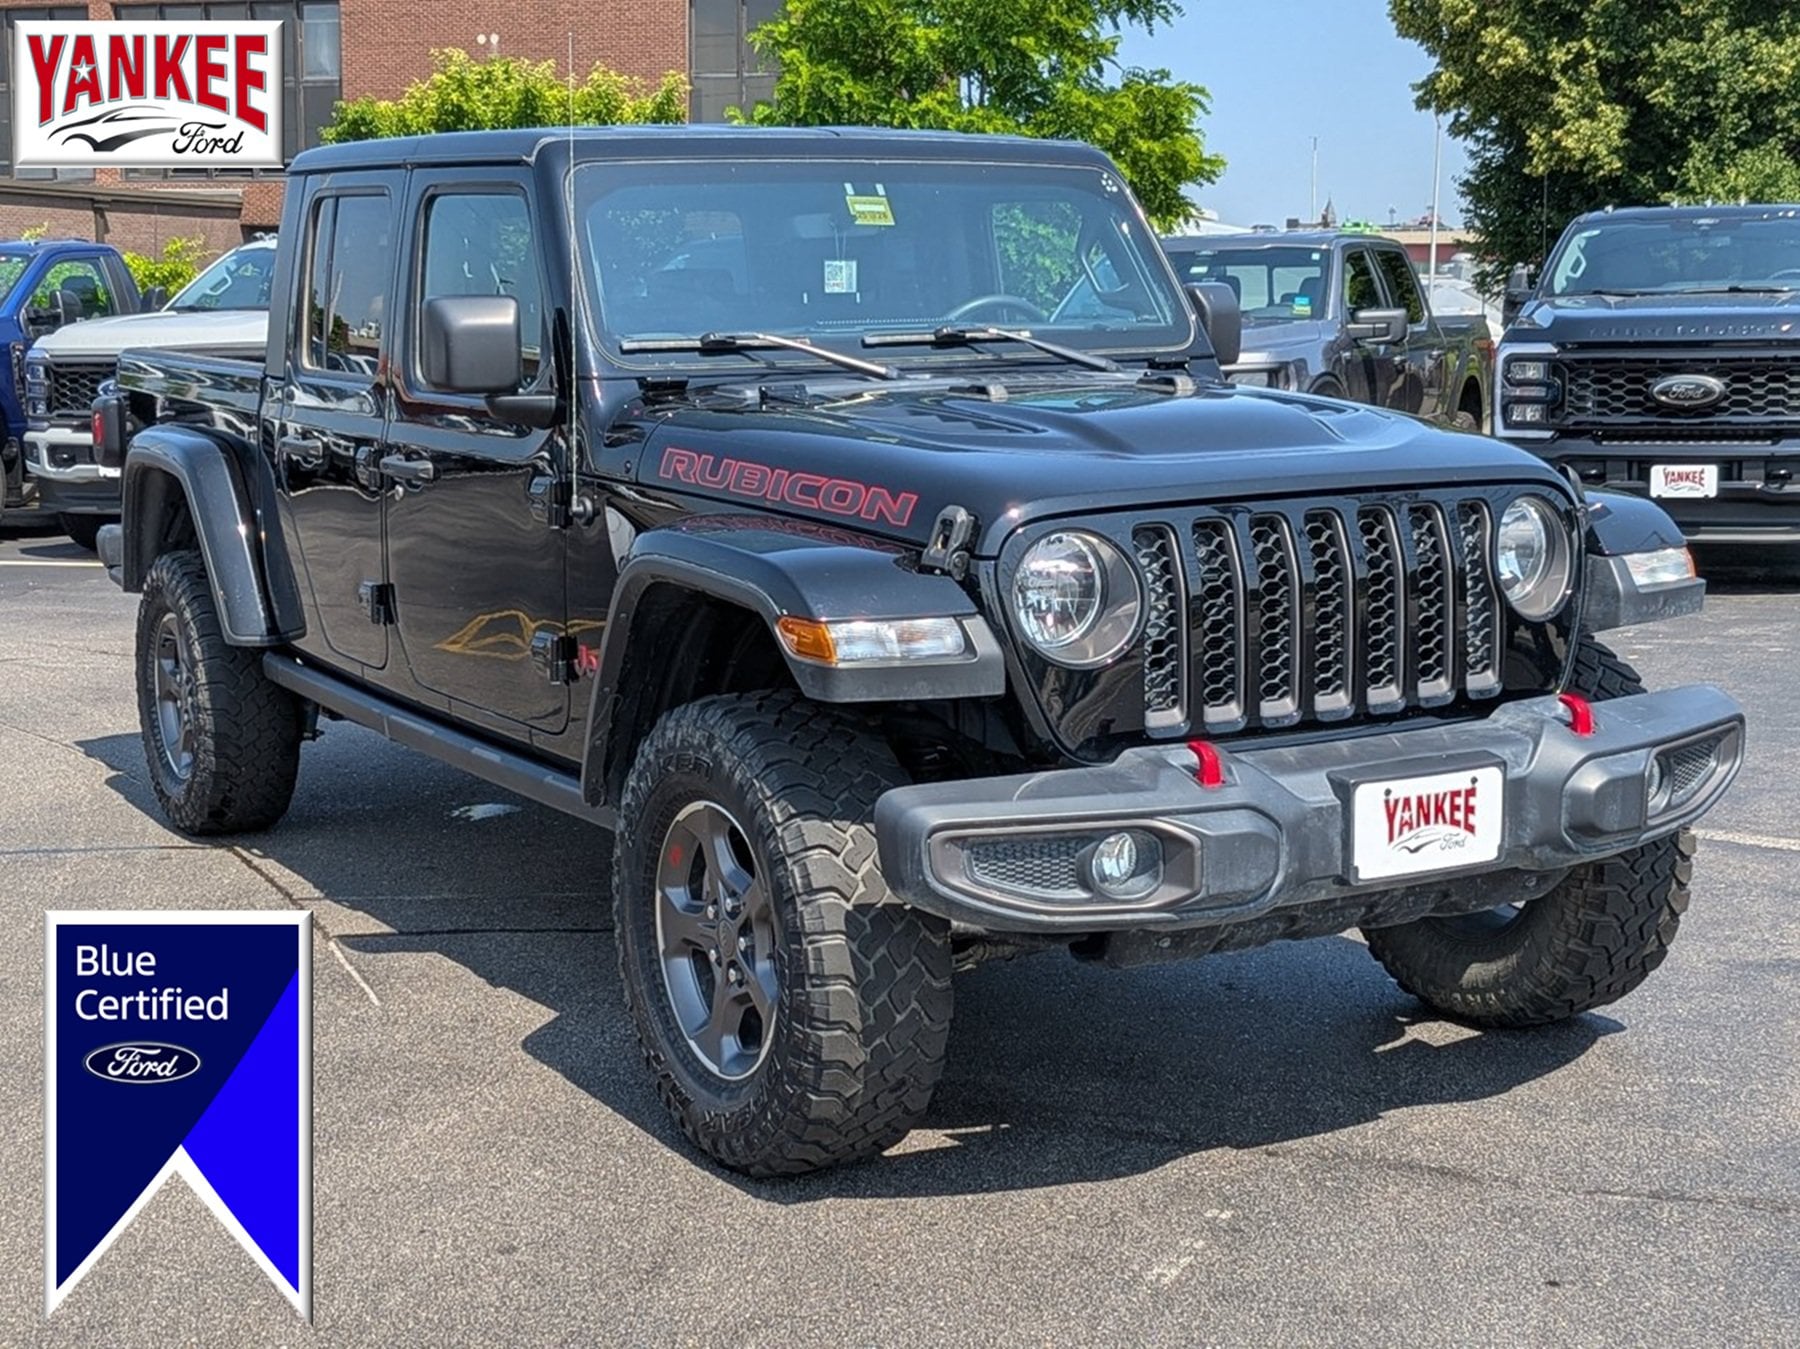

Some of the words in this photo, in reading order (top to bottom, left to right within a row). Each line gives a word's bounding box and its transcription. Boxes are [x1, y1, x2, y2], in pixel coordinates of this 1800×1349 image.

[1668, 384, 1705, 398] Ford
[659, 447, 918, 527] RUBICON
[1663, 468, 1705, 488] YANKEE
[1384, 786, 1477, 845] YANKEE
[1440, 833, 1467, 850] Ford
